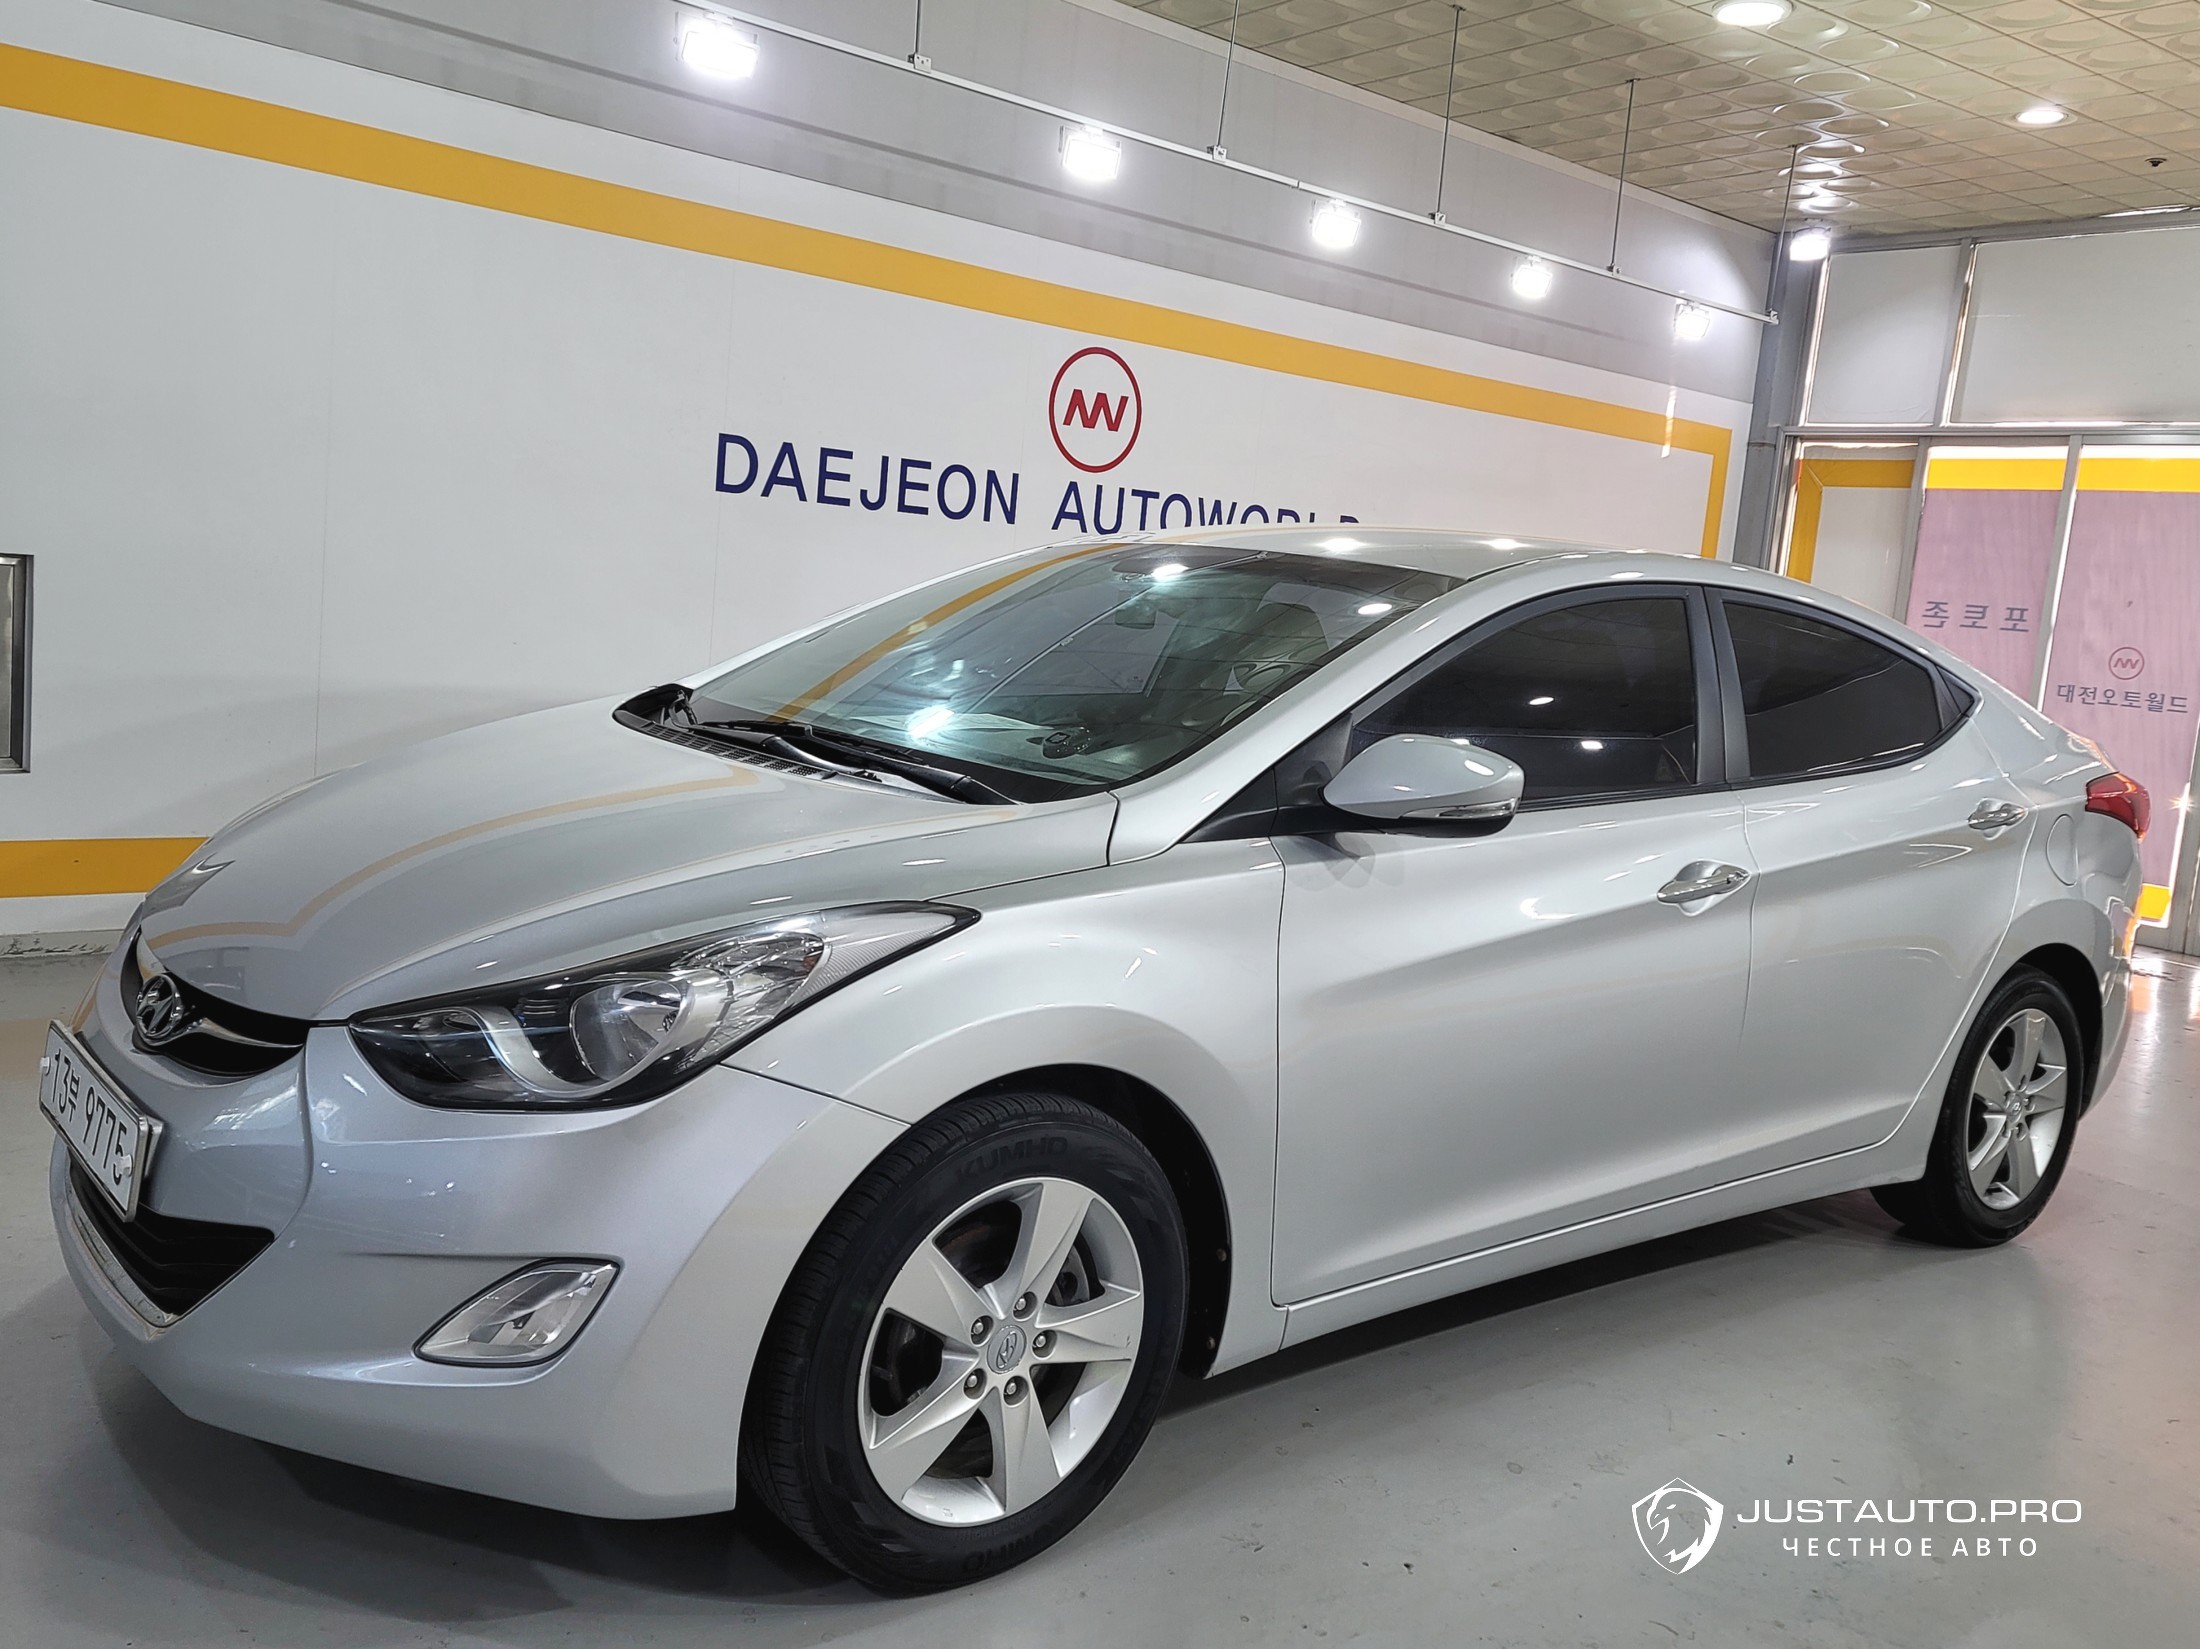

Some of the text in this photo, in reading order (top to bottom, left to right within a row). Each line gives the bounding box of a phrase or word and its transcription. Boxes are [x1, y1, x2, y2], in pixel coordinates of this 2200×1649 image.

[715, 432, 1360, 535] DAEJEON AUTOW
[2056, 683, 2189, 714] 대전오토월드
[53, 1047, 128, 1187] 13부 9775
[958, 1135, 1069, 1180] KUMHO
